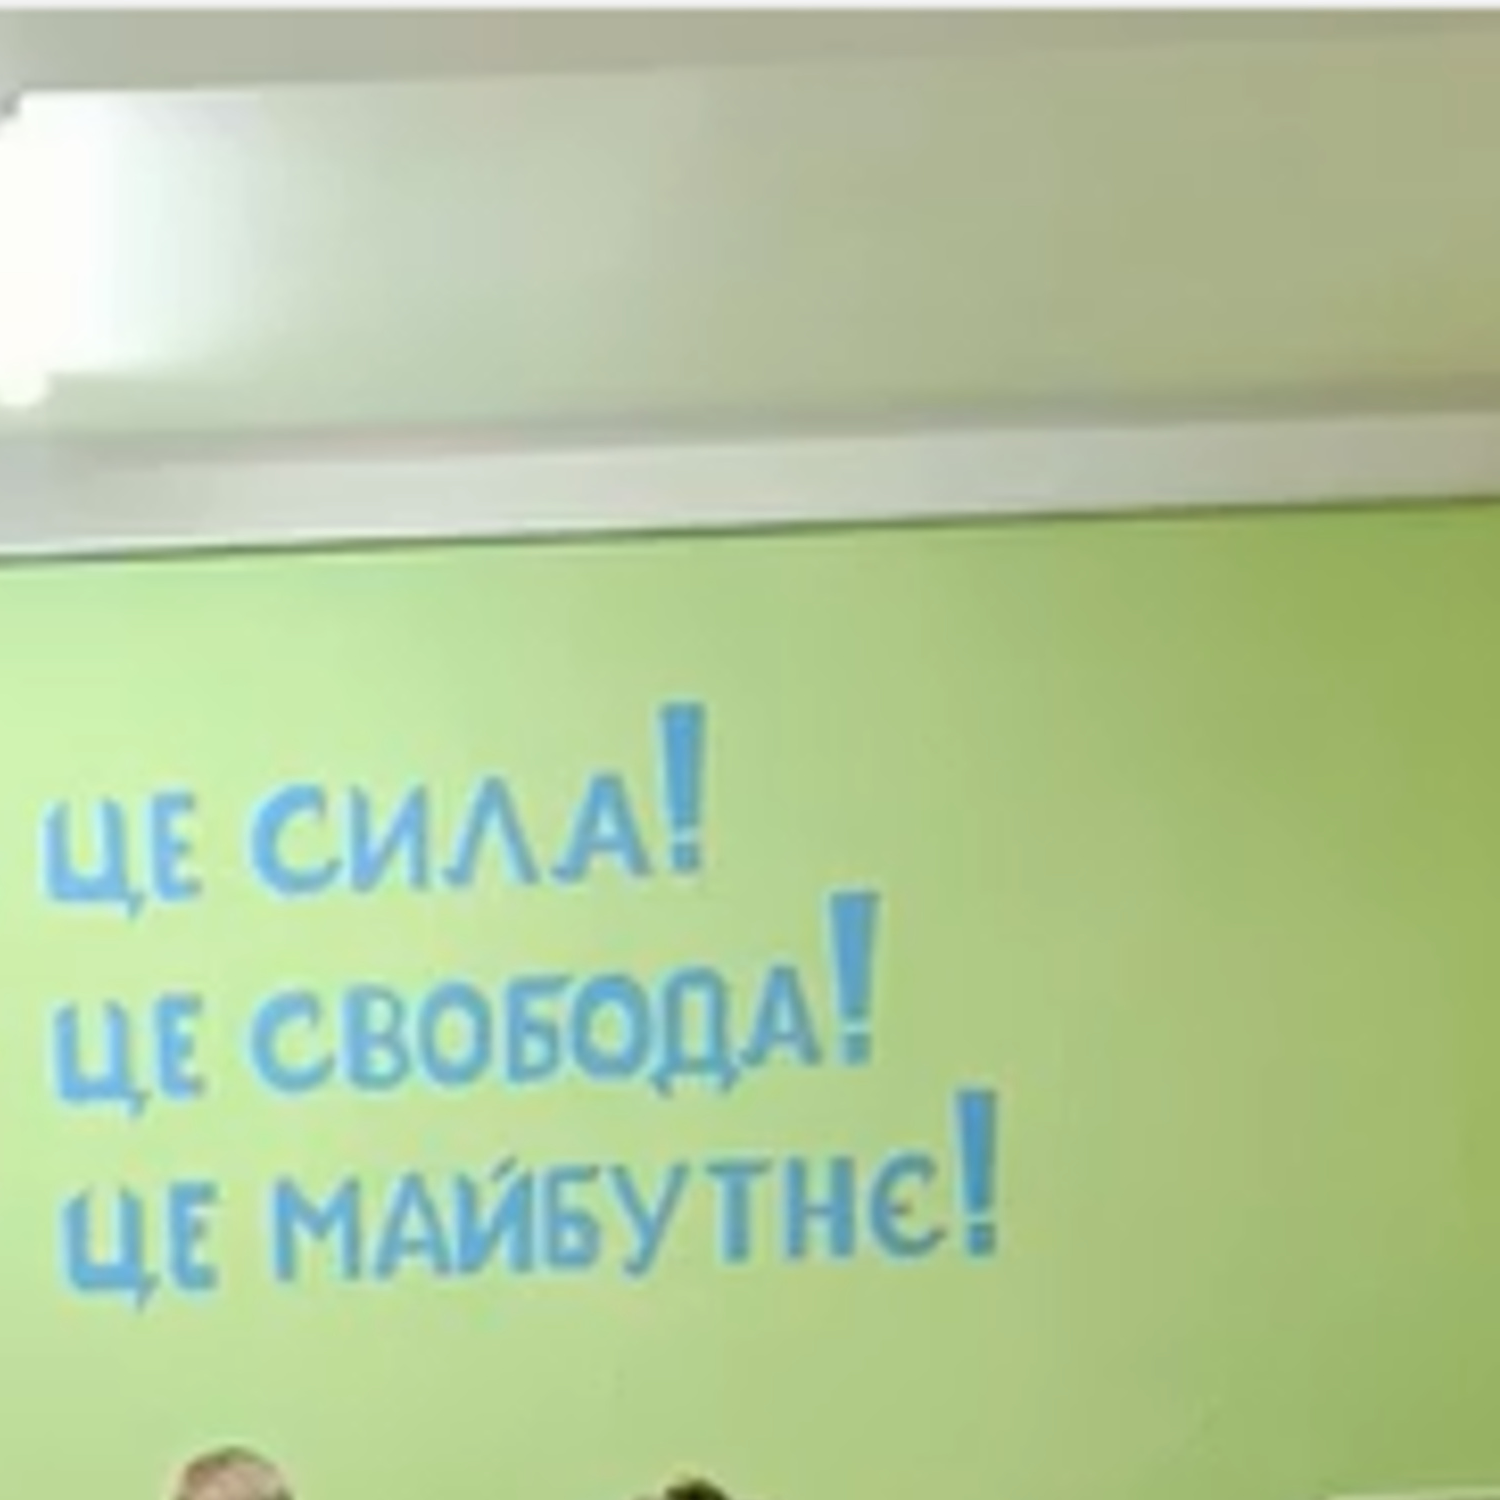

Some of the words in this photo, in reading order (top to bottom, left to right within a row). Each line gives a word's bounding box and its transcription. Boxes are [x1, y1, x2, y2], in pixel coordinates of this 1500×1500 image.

[43, 791, 202, 917] ЦЕ
[249, 702, 707, 893] СИЛА!
[53, 993, 205, 1117] ЦЕ
[249, 890, 880, 1097] СВОБОДА!
[63, 1181, 219, 1312] ЦЕ
[270, 1089, 998, 1281] МАЙБУТНЄ!
